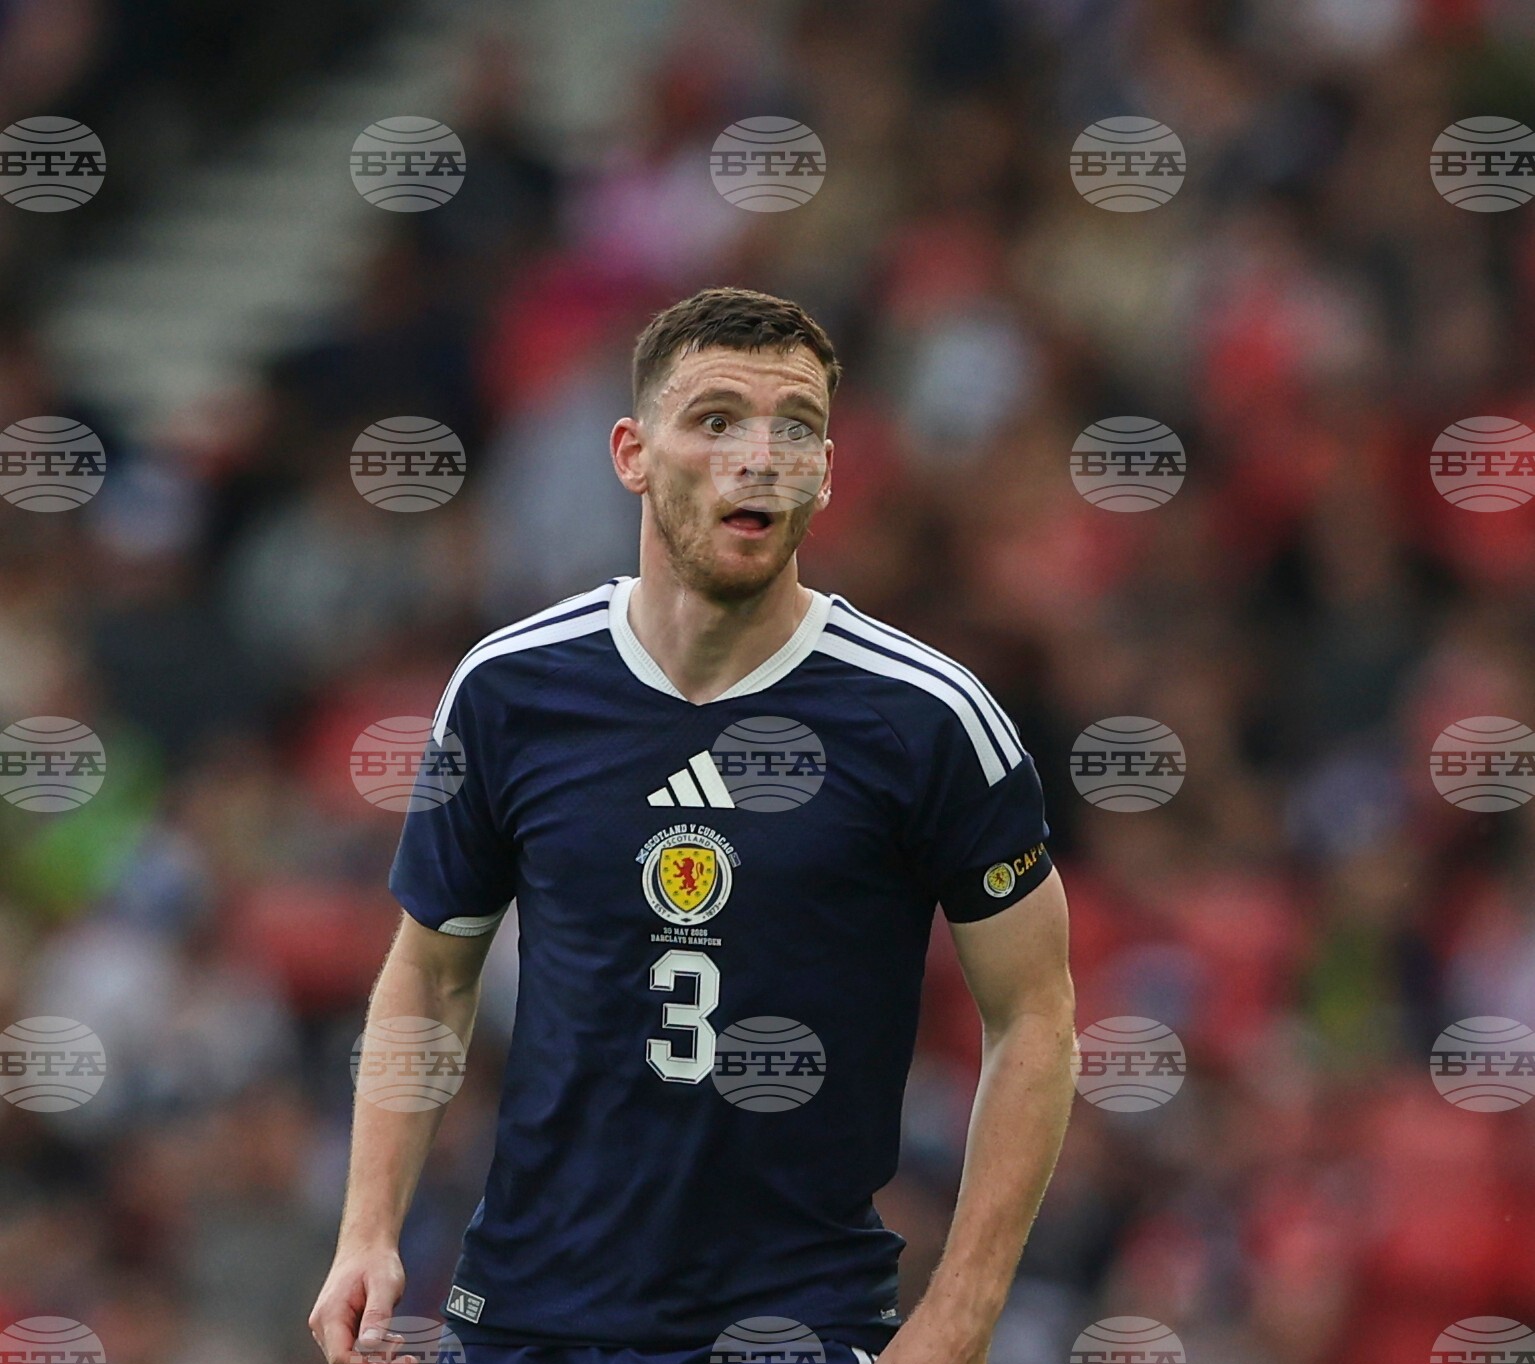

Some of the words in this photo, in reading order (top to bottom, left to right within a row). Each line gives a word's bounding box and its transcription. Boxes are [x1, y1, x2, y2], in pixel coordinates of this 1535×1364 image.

[643, 824, 688, 853] SCOTLAND
[690, 824, 697, 833] V
[666, 835, 711, 847] SCOTLAND
[674, 927, 689, 936] MAY
[650, 934, 687, 944] BARCLAYS
[688, 936, 722, 946] HAMPDEN
[646, 949, 720, 1084] 3
